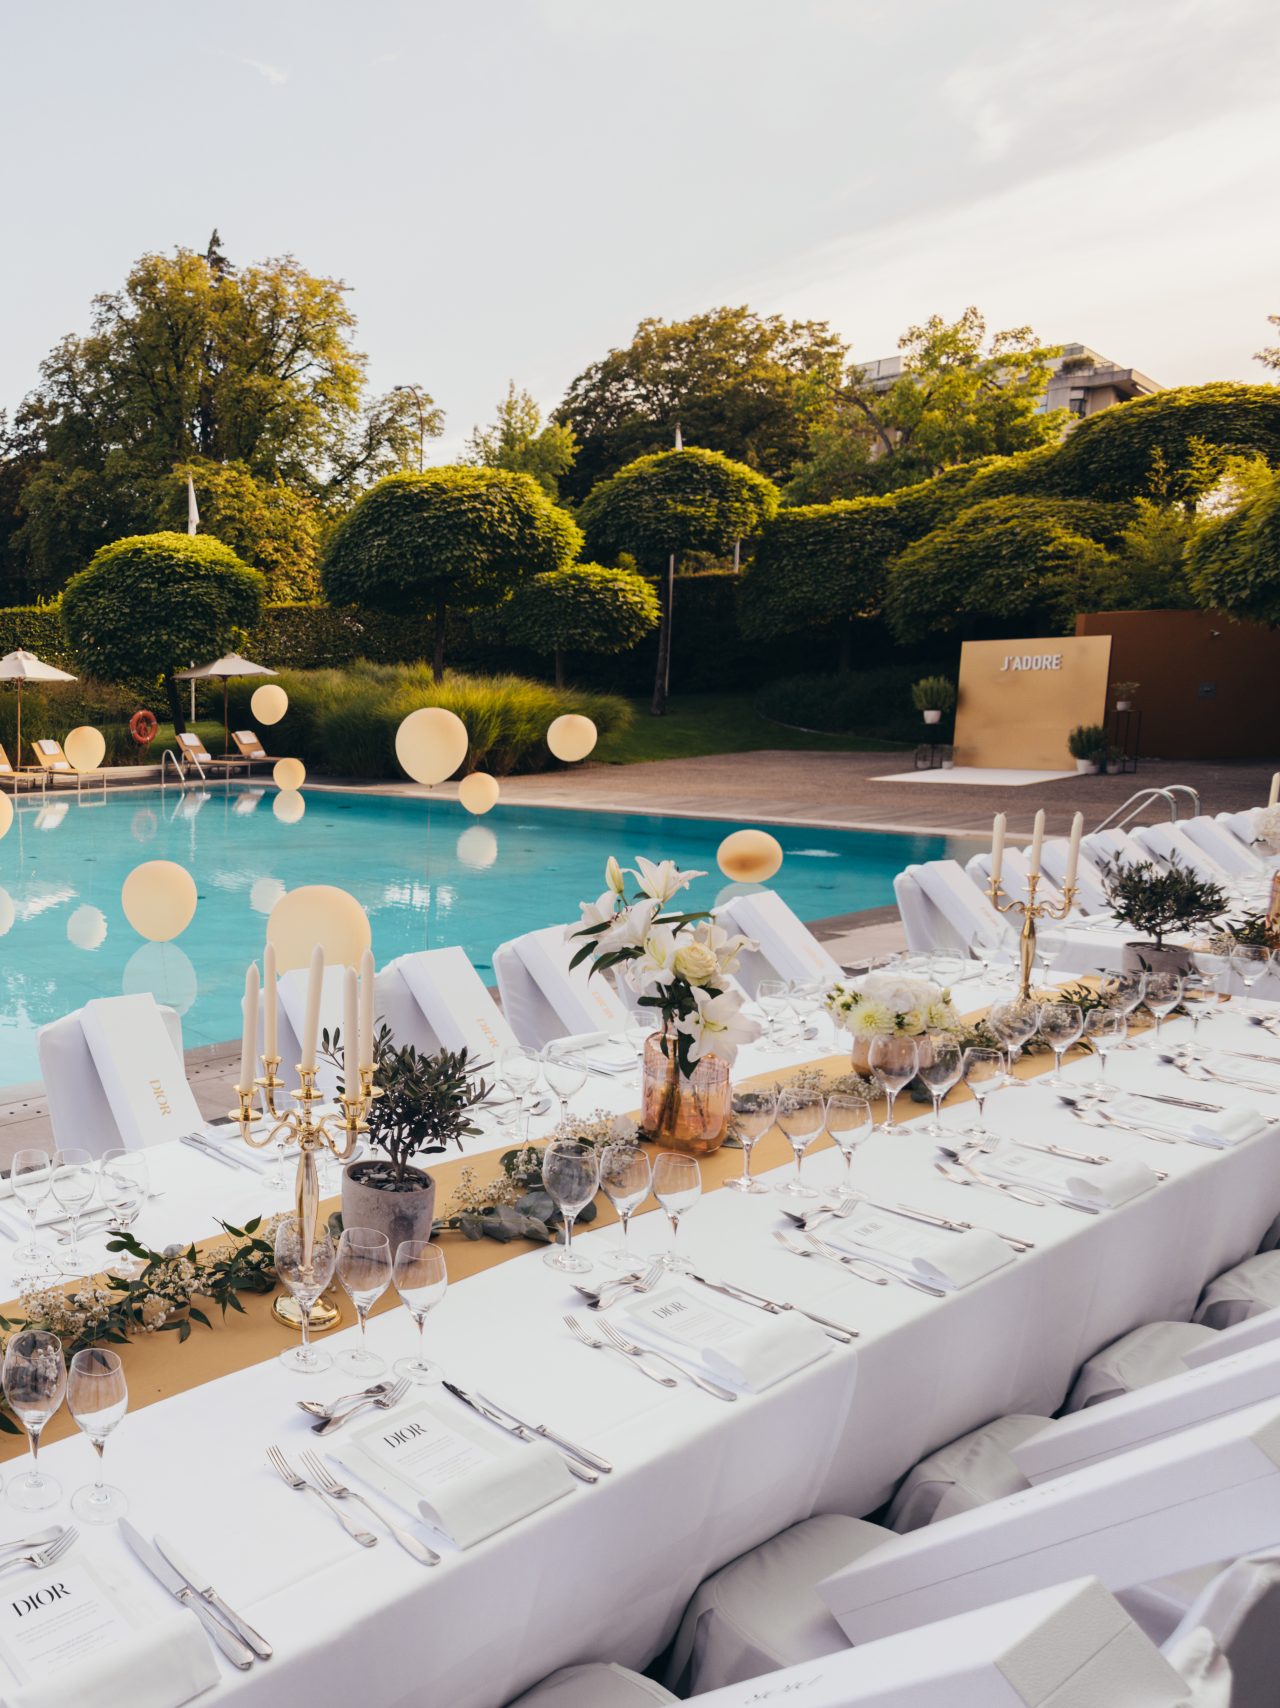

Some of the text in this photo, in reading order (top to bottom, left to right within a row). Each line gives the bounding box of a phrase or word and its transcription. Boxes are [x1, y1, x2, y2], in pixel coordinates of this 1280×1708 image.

[1000, 654, 1063, 672] J'ADORE
[149, 1079, 171, 1117] DIOR
[651, 1301, 689, 1320] DIOR
[383, 1422, 428, 1449] DIOR
[11, 1582, 71, 1617] DIOR
